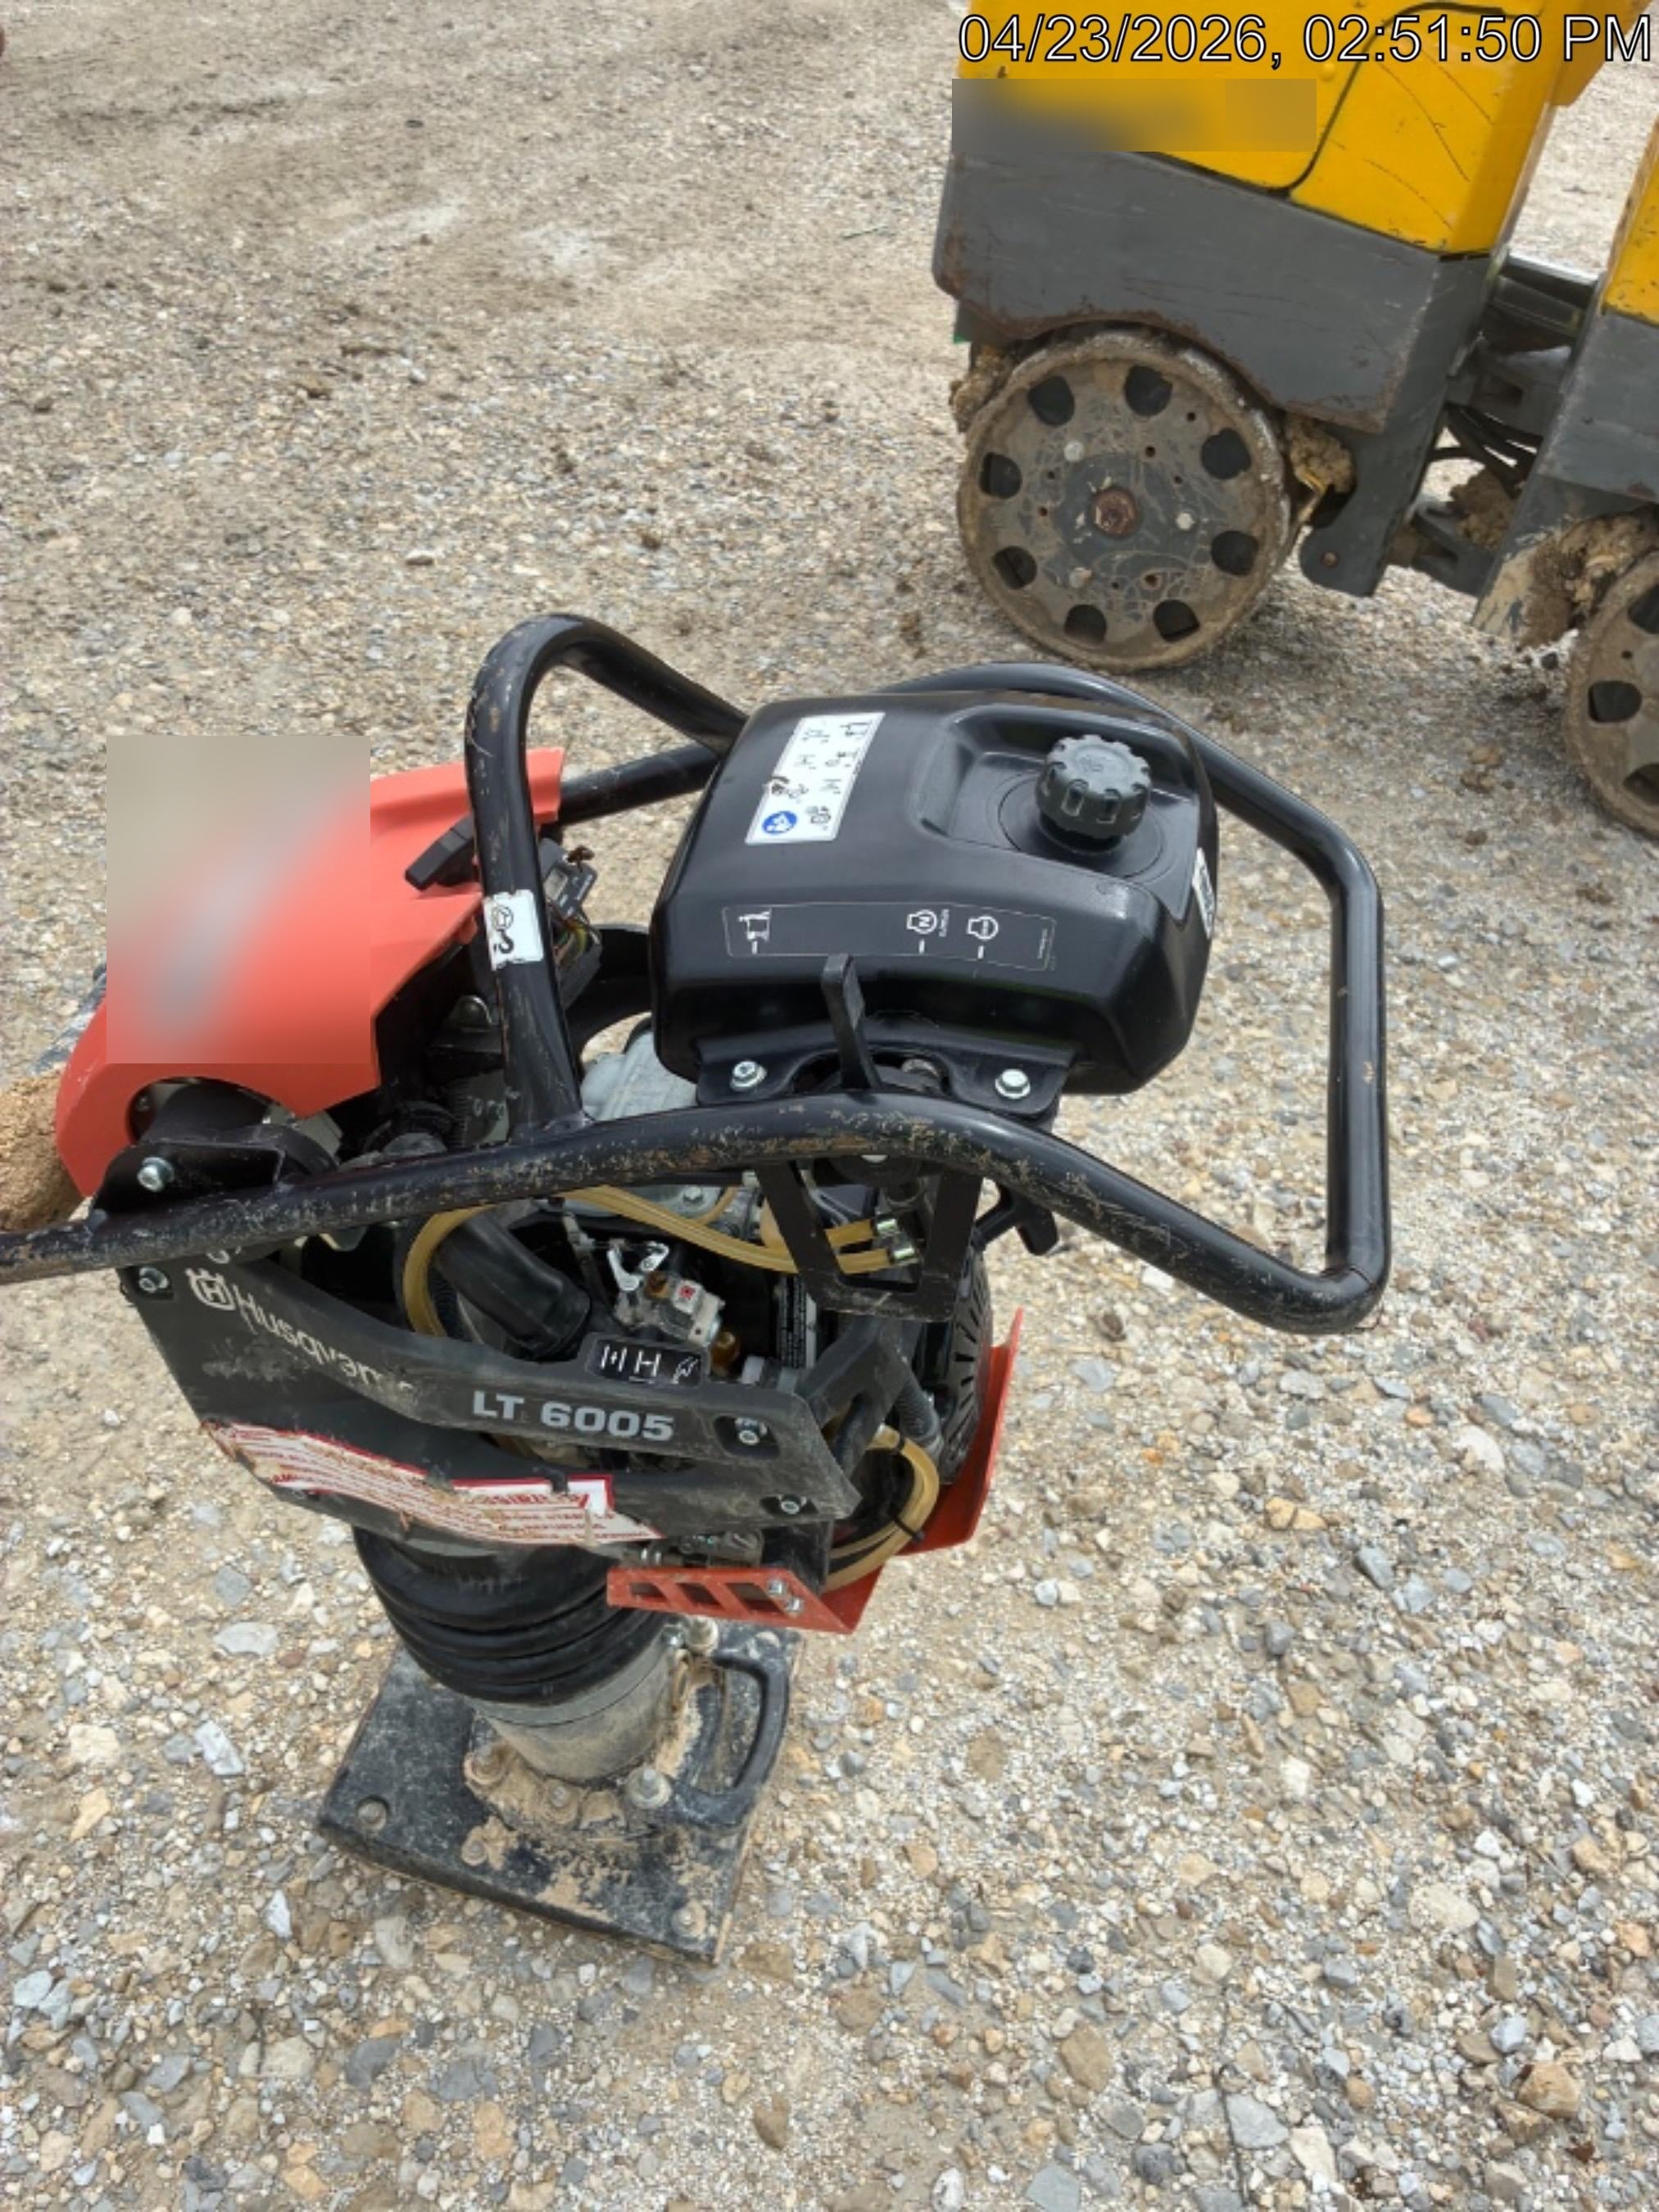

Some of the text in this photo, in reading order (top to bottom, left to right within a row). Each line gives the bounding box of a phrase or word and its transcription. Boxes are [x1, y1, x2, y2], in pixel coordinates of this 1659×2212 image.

[233, 1283, 419, 1404] Husqvar
[473, 1390, 674, 1441] LT 6005
